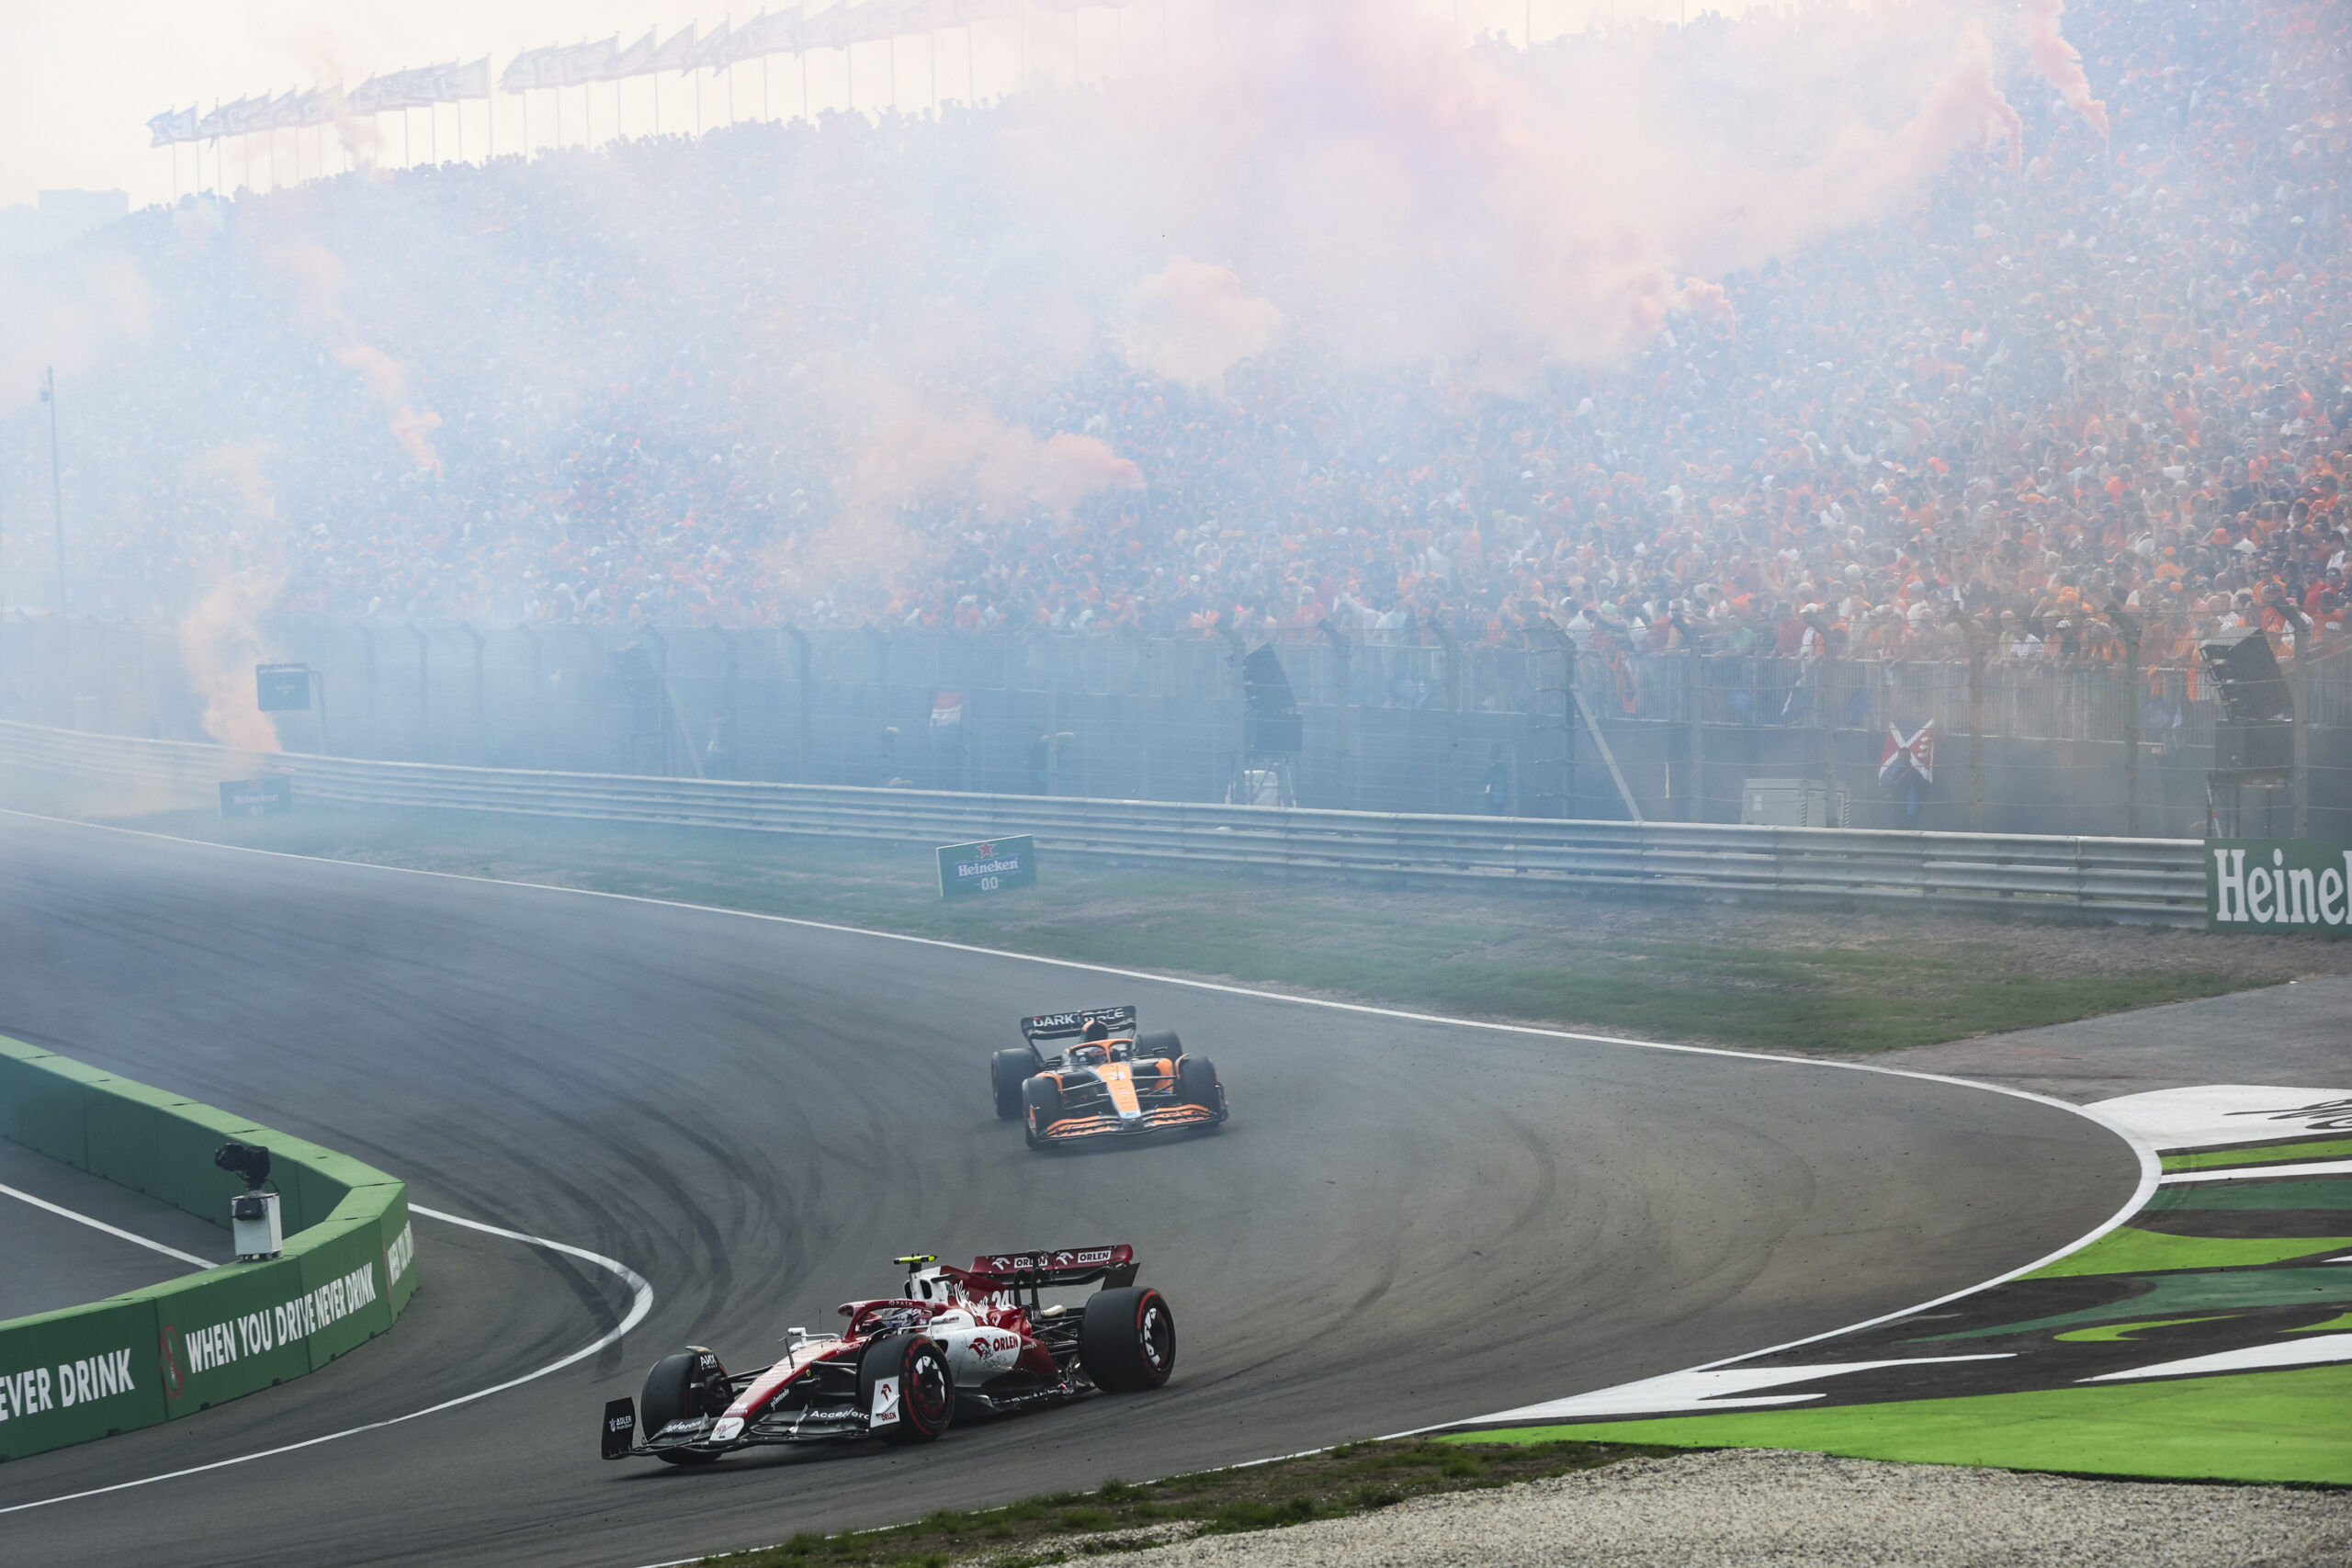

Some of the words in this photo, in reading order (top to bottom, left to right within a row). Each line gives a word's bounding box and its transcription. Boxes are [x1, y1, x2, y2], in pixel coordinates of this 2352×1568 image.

[957, 859, 1019, 877] Heineken
[1016, 1256, 1046, 1267] ORLN
[1080, 1251, 1111, 1261] ORLEN
[992, 1289, 1017, 1312] 24
[186, 1320, 237, 1374] WHEN
[237, 1309, 273, 1357] YOU
[276, 1292, 316, 1347] DRIVE
[314, 1278, 347, 1329] NEVER
[345, 1261, 377, 1314] DRINK
[992, 1335, 1019, 1352] ORLEN
[58, 1348, 136, 1408] DRINK
